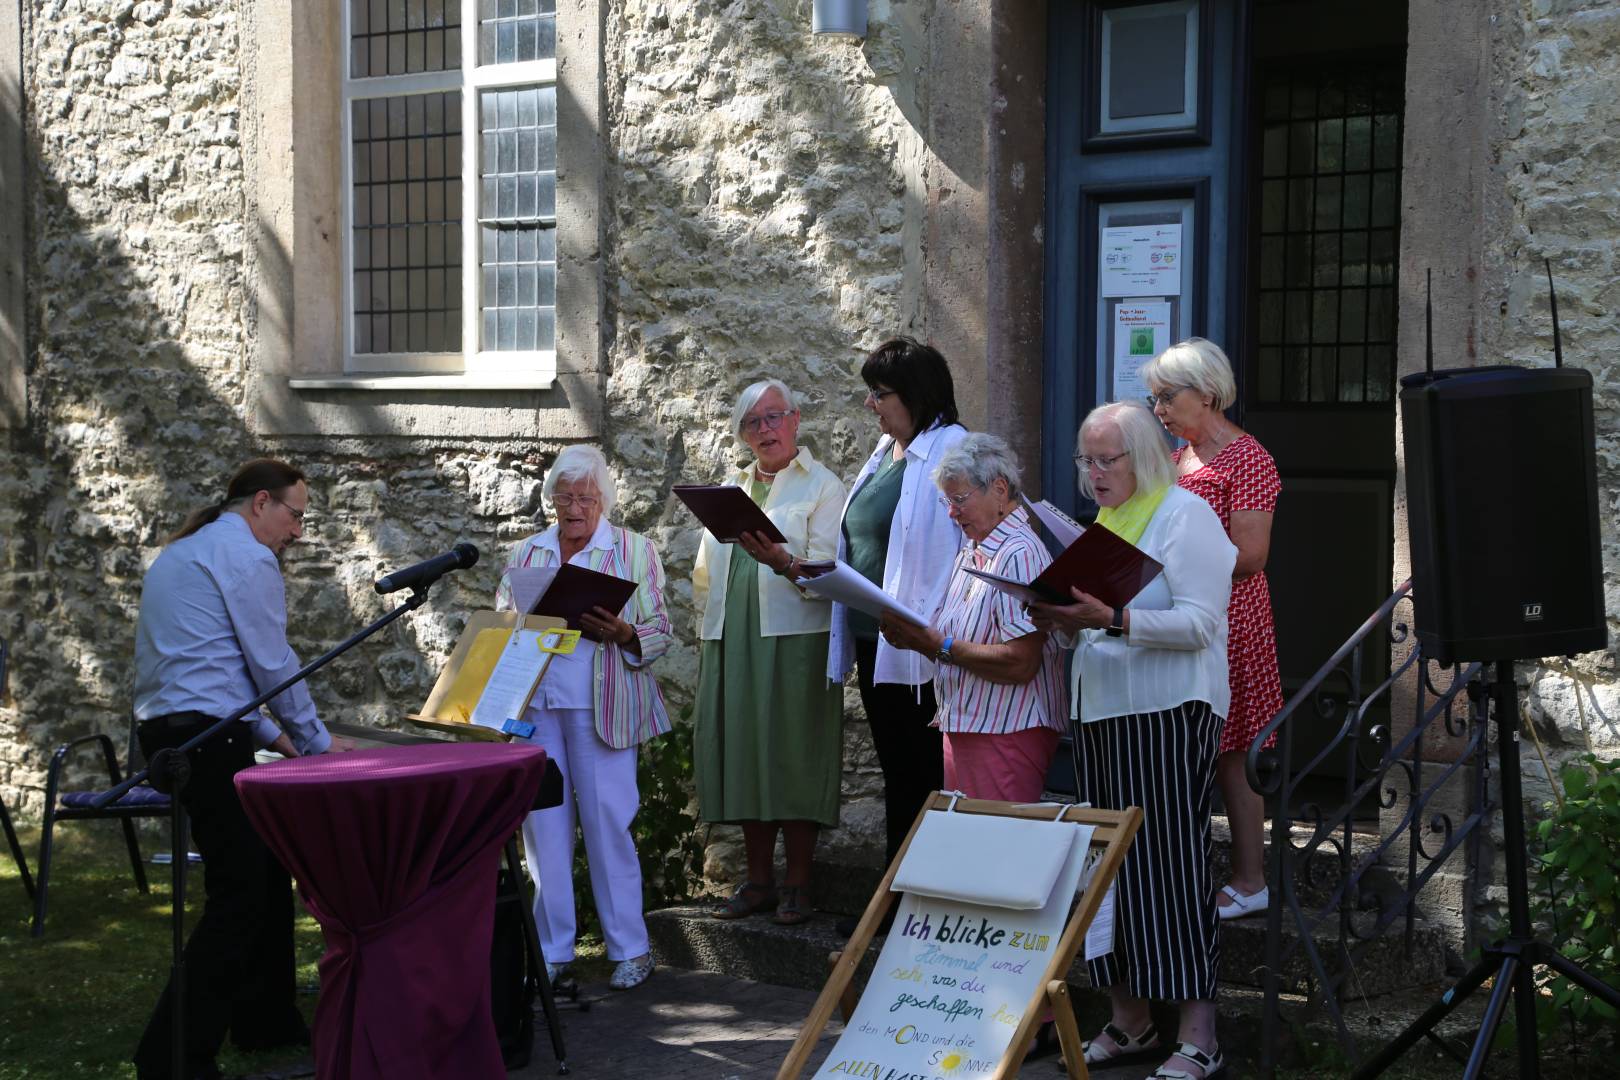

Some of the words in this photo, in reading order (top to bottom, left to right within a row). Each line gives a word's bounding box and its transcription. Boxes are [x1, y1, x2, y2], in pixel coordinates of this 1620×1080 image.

[901, 913, 932, 941] Ich
[935, 913, 1006, 949] blicke
[1008, 930, 1050, 951] zum
[915, 943, 988, 973] Himmel
[992, 959, 1031, 975] und
[932, 974, 957, 988] was
[961, 976, 985, 994] du
[889, 992, 983, 1023] geschaffen
[858, 1022, 878, 1034] den
[932, 1034, 952, 1048] und
[956, 1035, 976, 1049] die
